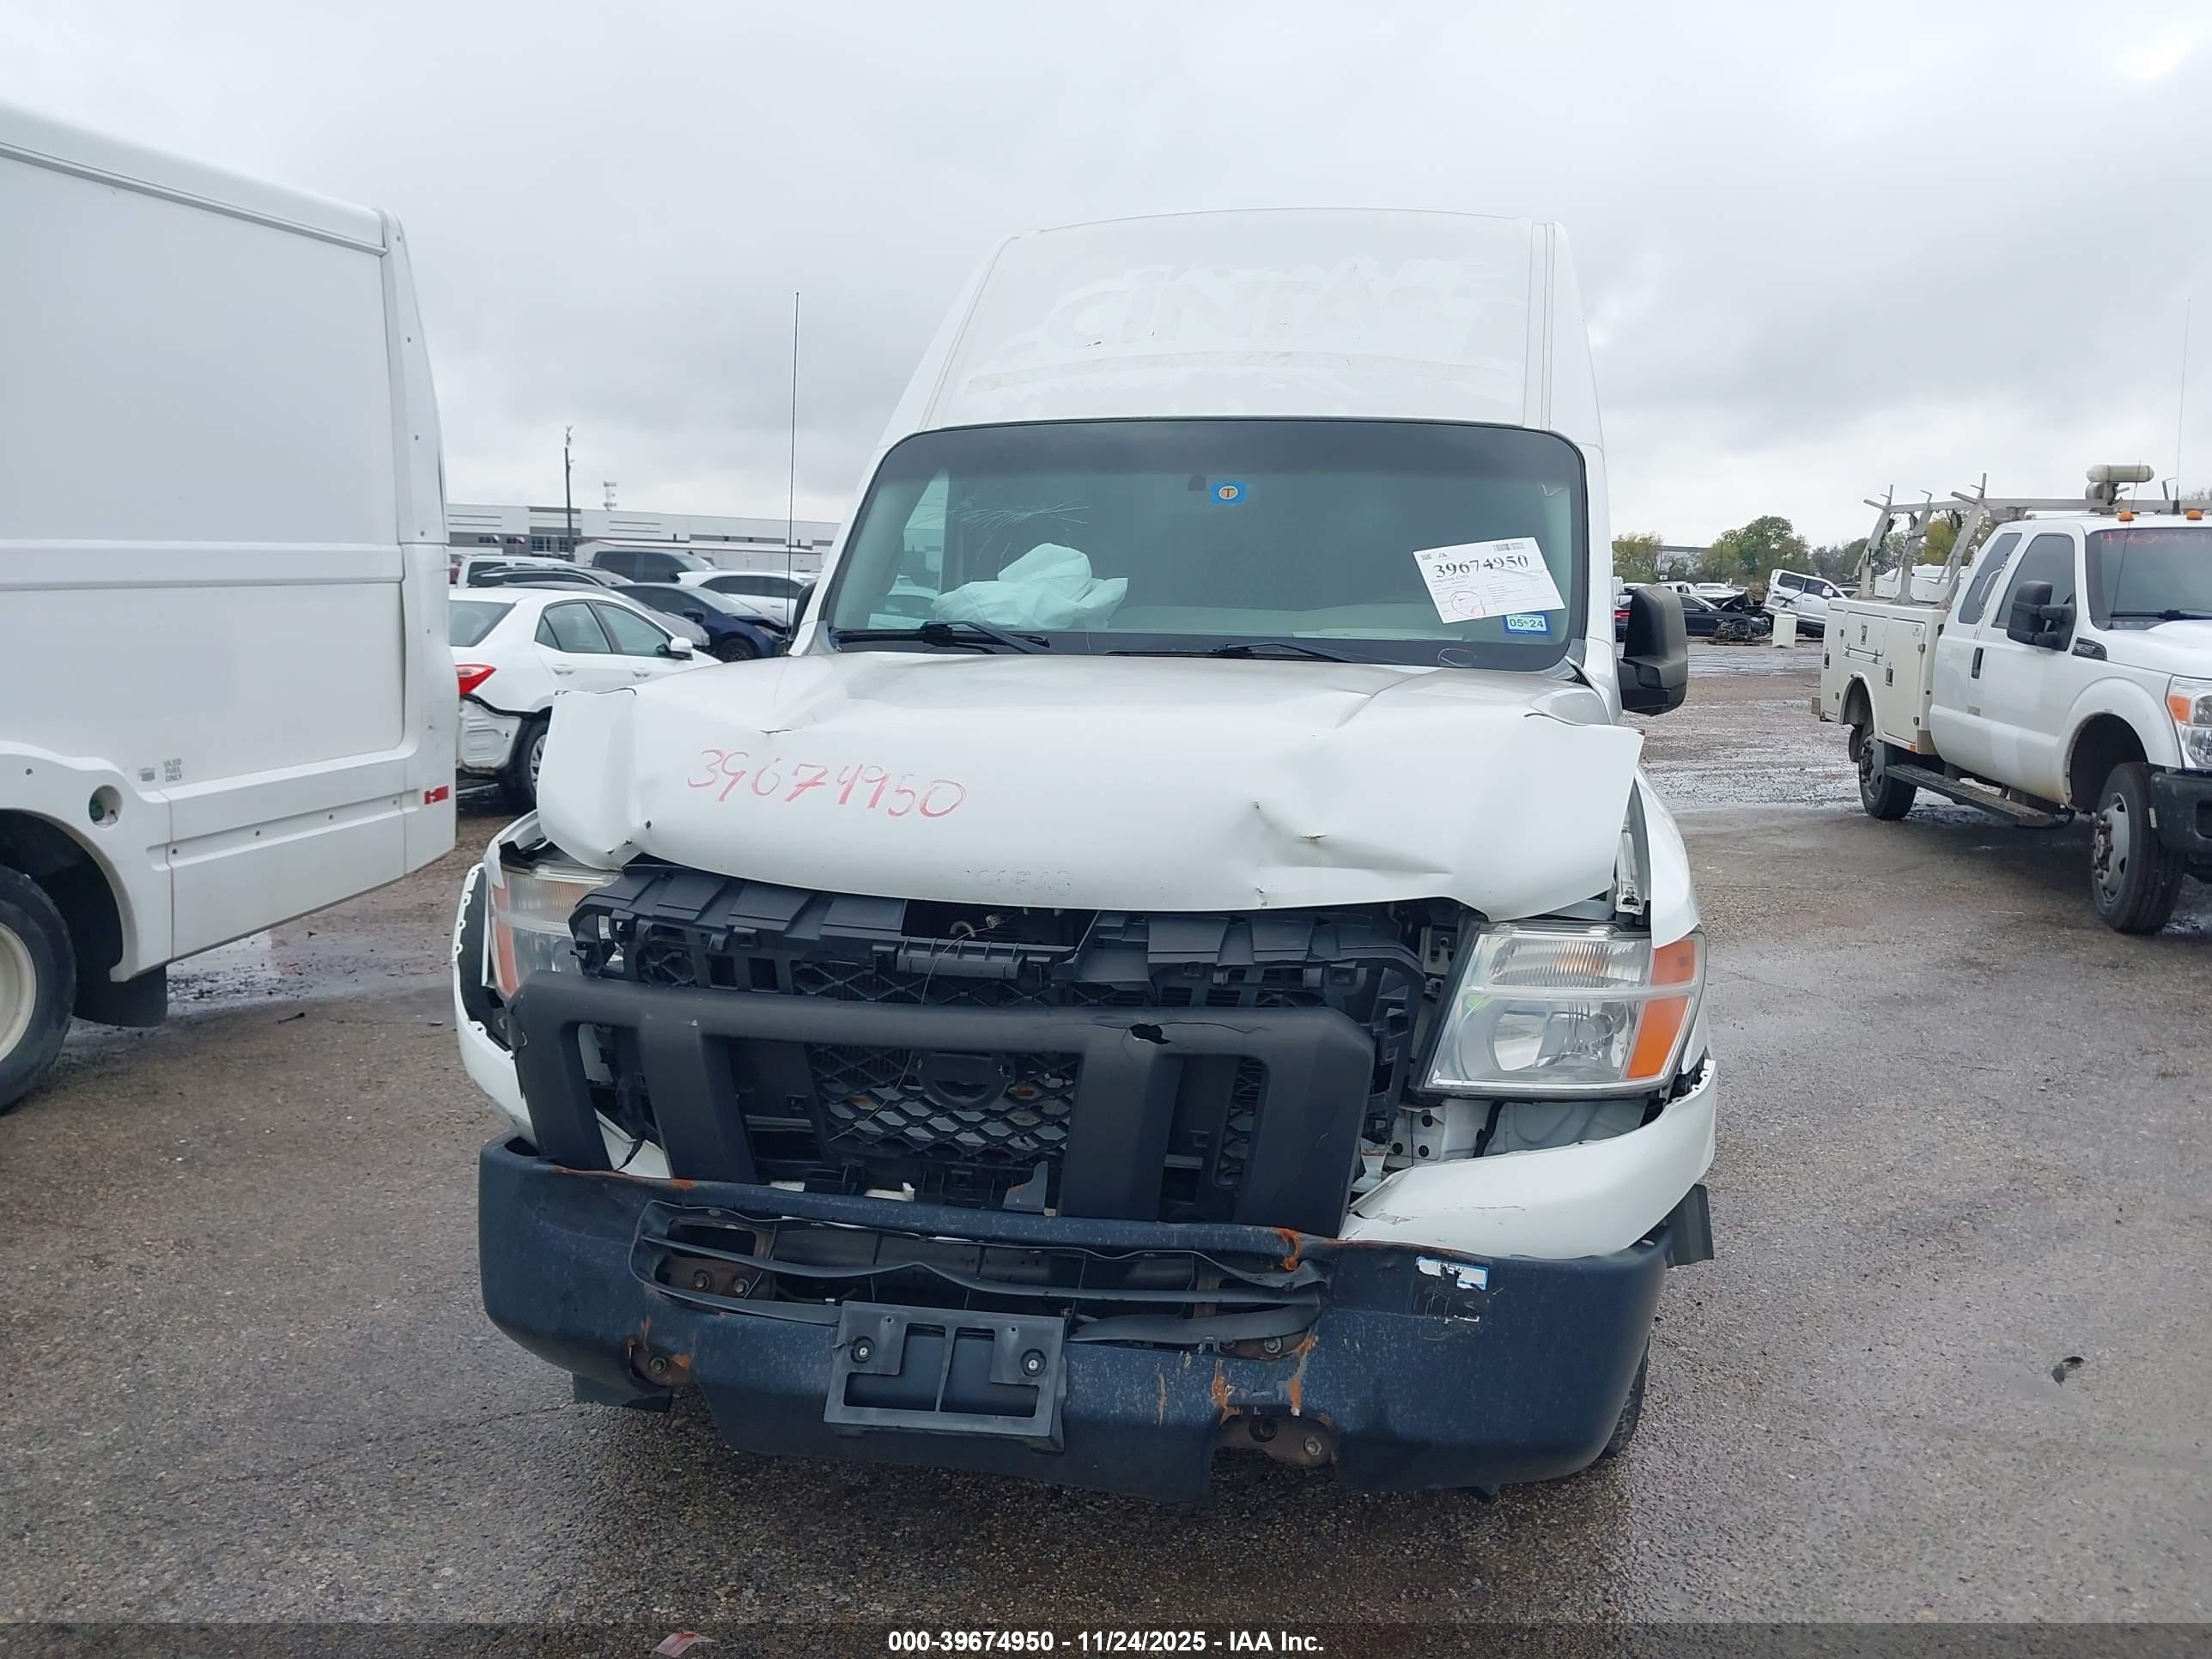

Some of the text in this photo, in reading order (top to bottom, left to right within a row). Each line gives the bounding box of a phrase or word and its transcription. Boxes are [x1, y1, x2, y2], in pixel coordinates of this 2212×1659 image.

[1432, 554, 1529, 579] 39674950
[1509, 618, 1544, 629] 05 24
[688, 749, 969, 818] 39674950
